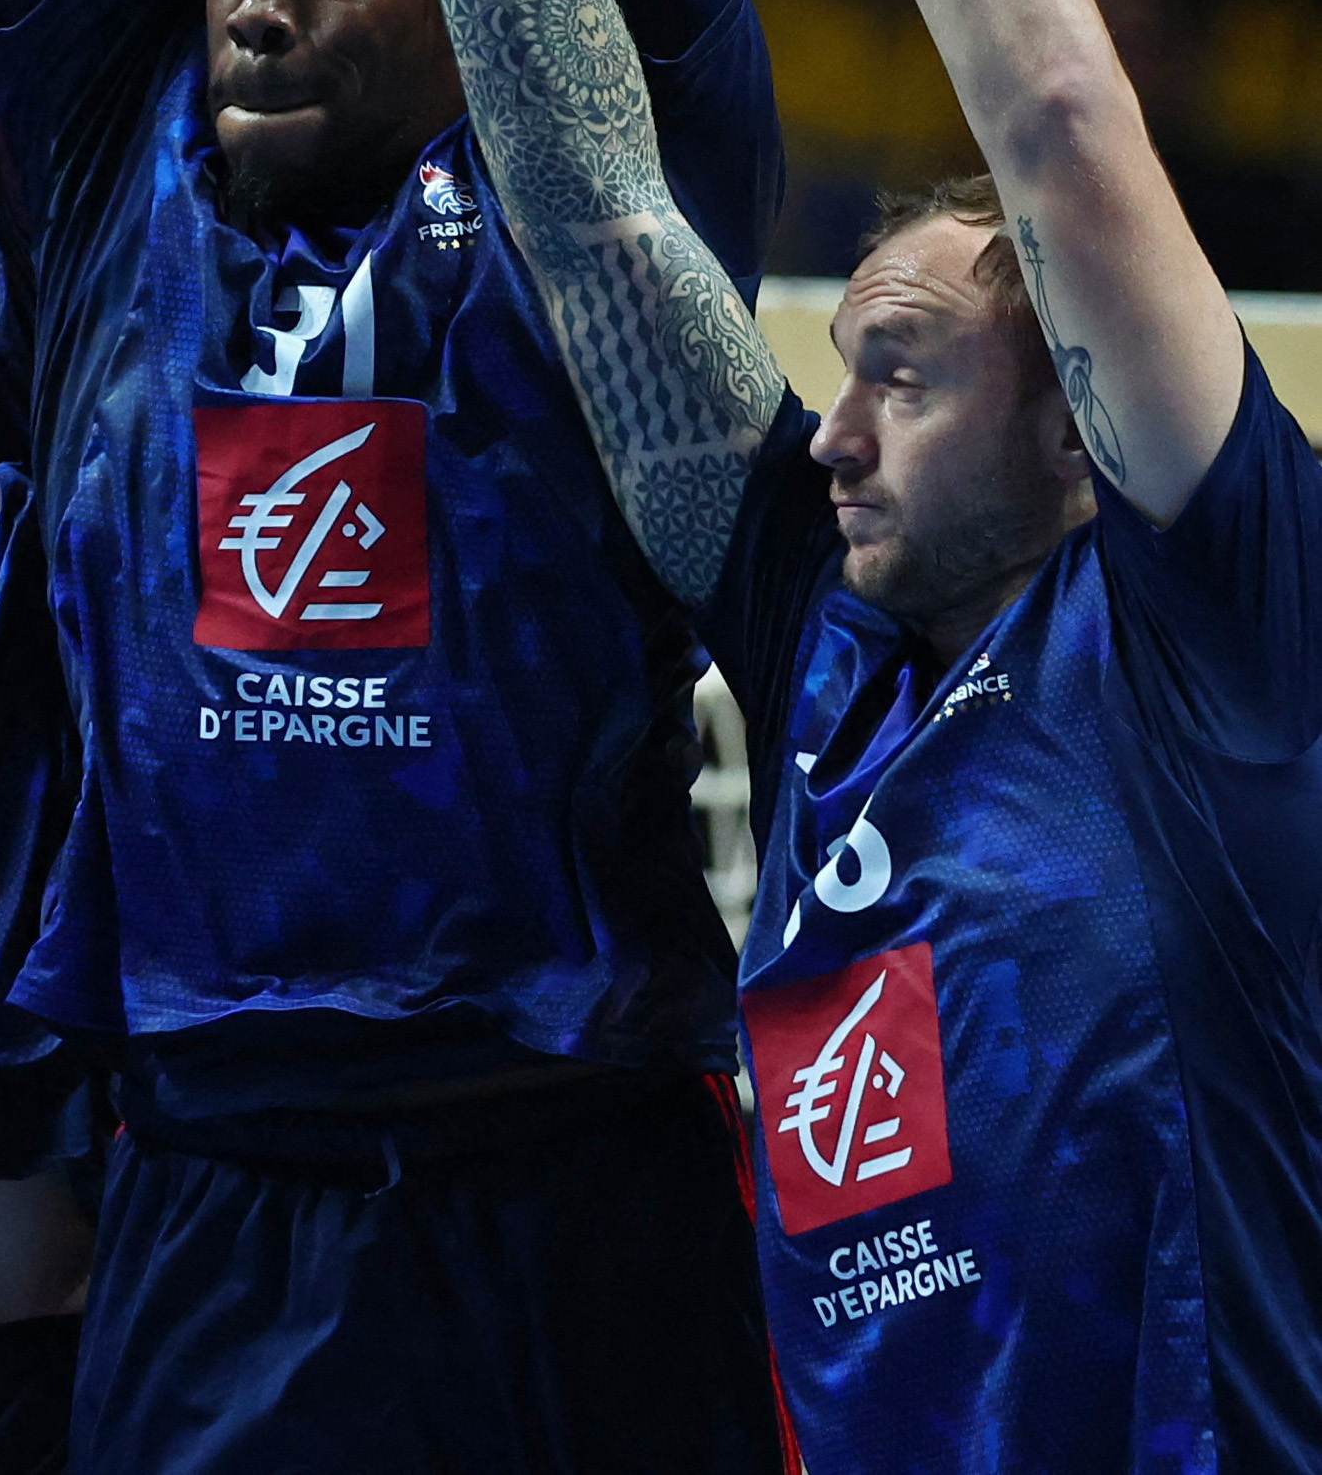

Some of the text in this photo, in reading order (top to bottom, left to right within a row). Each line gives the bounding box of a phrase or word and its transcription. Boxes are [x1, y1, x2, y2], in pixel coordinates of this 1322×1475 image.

[236, 672, 388, 709] CAISSE
[199, 706, 432, 748] D'EPARGNE
[829, 1219, 939, 1280] CAISSE
[812, 1248, 981, 1328] D'EPARGNE
